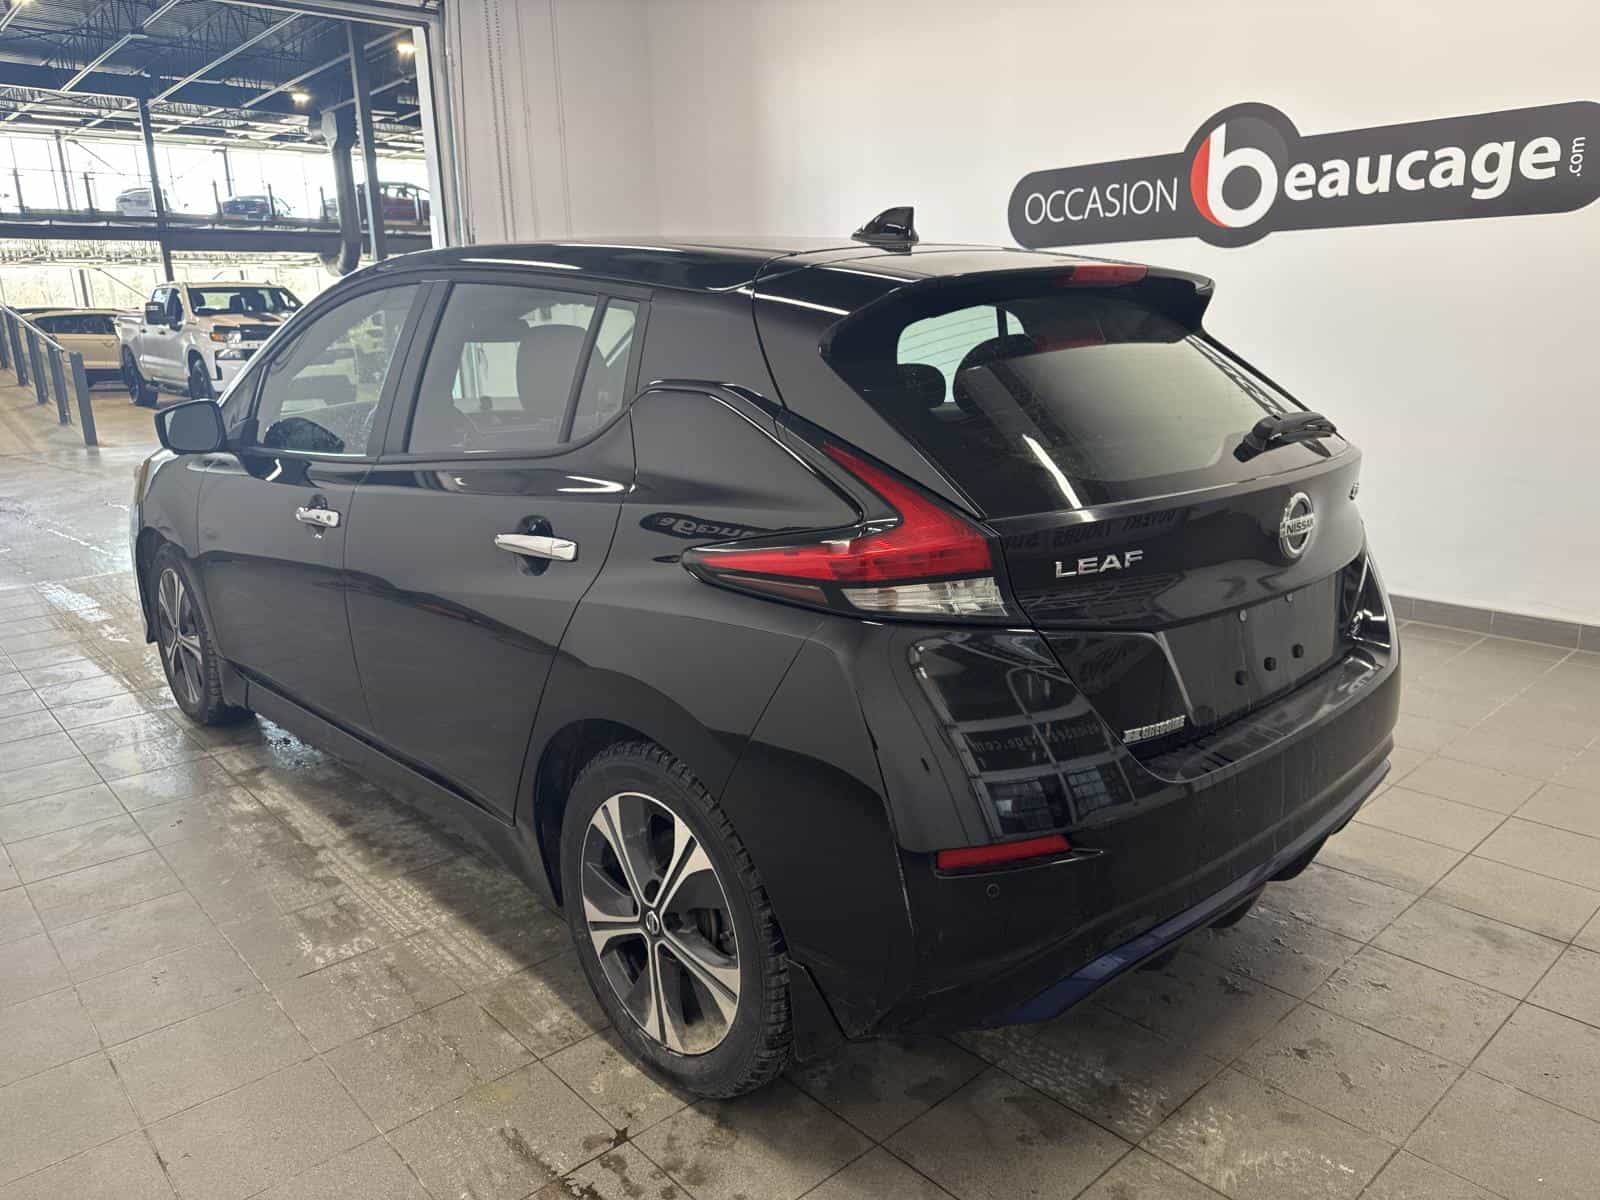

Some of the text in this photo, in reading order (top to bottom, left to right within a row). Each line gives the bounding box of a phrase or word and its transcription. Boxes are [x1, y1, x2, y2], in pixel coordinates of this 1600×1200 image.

[1024, 121, 1587, 229] OCCASION beaucage .com
[1055, 549, 1144, 578] LEAF
